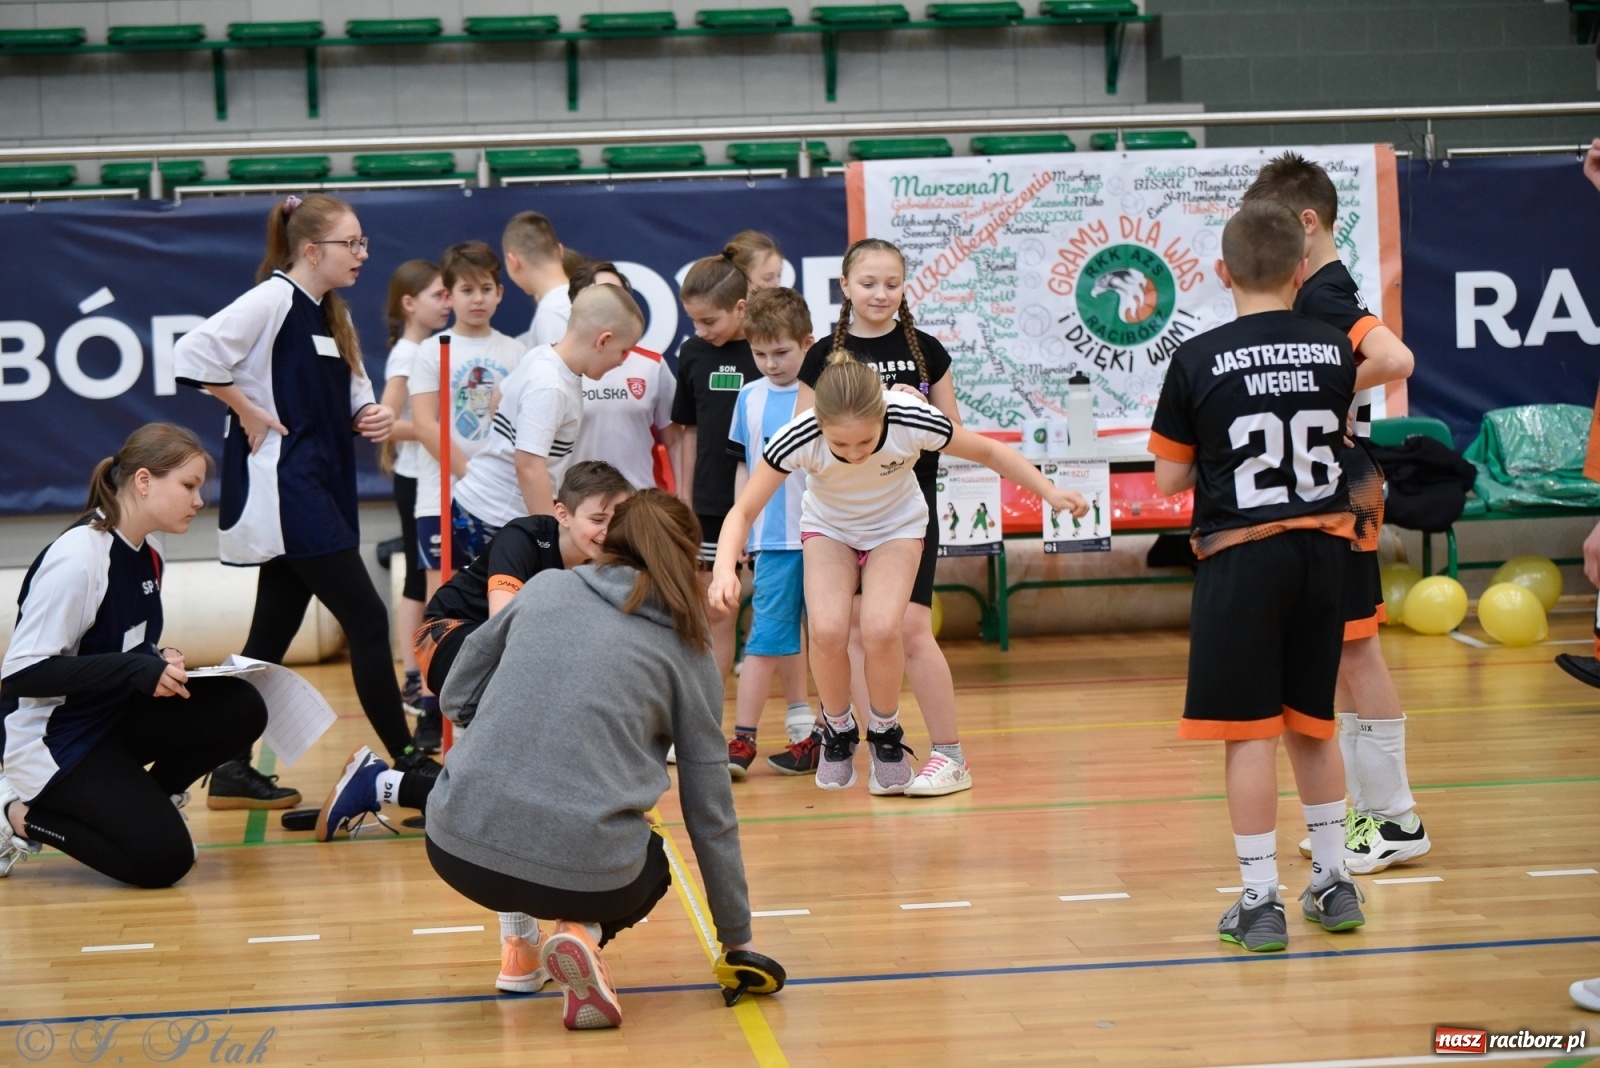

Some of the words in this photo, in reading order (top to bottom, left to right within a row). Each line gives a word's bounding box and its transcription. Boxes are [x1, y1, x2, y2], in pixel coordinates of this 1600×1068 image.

[890, 171, 1014, 197] MarzenaN
[1047, 219, 1109, 296] GRAMY
[1119, 215, 1161, 249] DLA
[1163, 237, 1204, 292] WAS
[1085, 250, 1121, 279] RKK
[1131, 249, 1164, 277] AZS
[719, 365, 736, 373] SON
[1211, 343, 1342, 376] JASTRZĘBSKI
[881, 373, 897, 381] PPY
[1244, 370, 1320, 396] WĘGIEL
[1228, 409, 1342, 509] 26
[142, 580, 154, 595] SP
